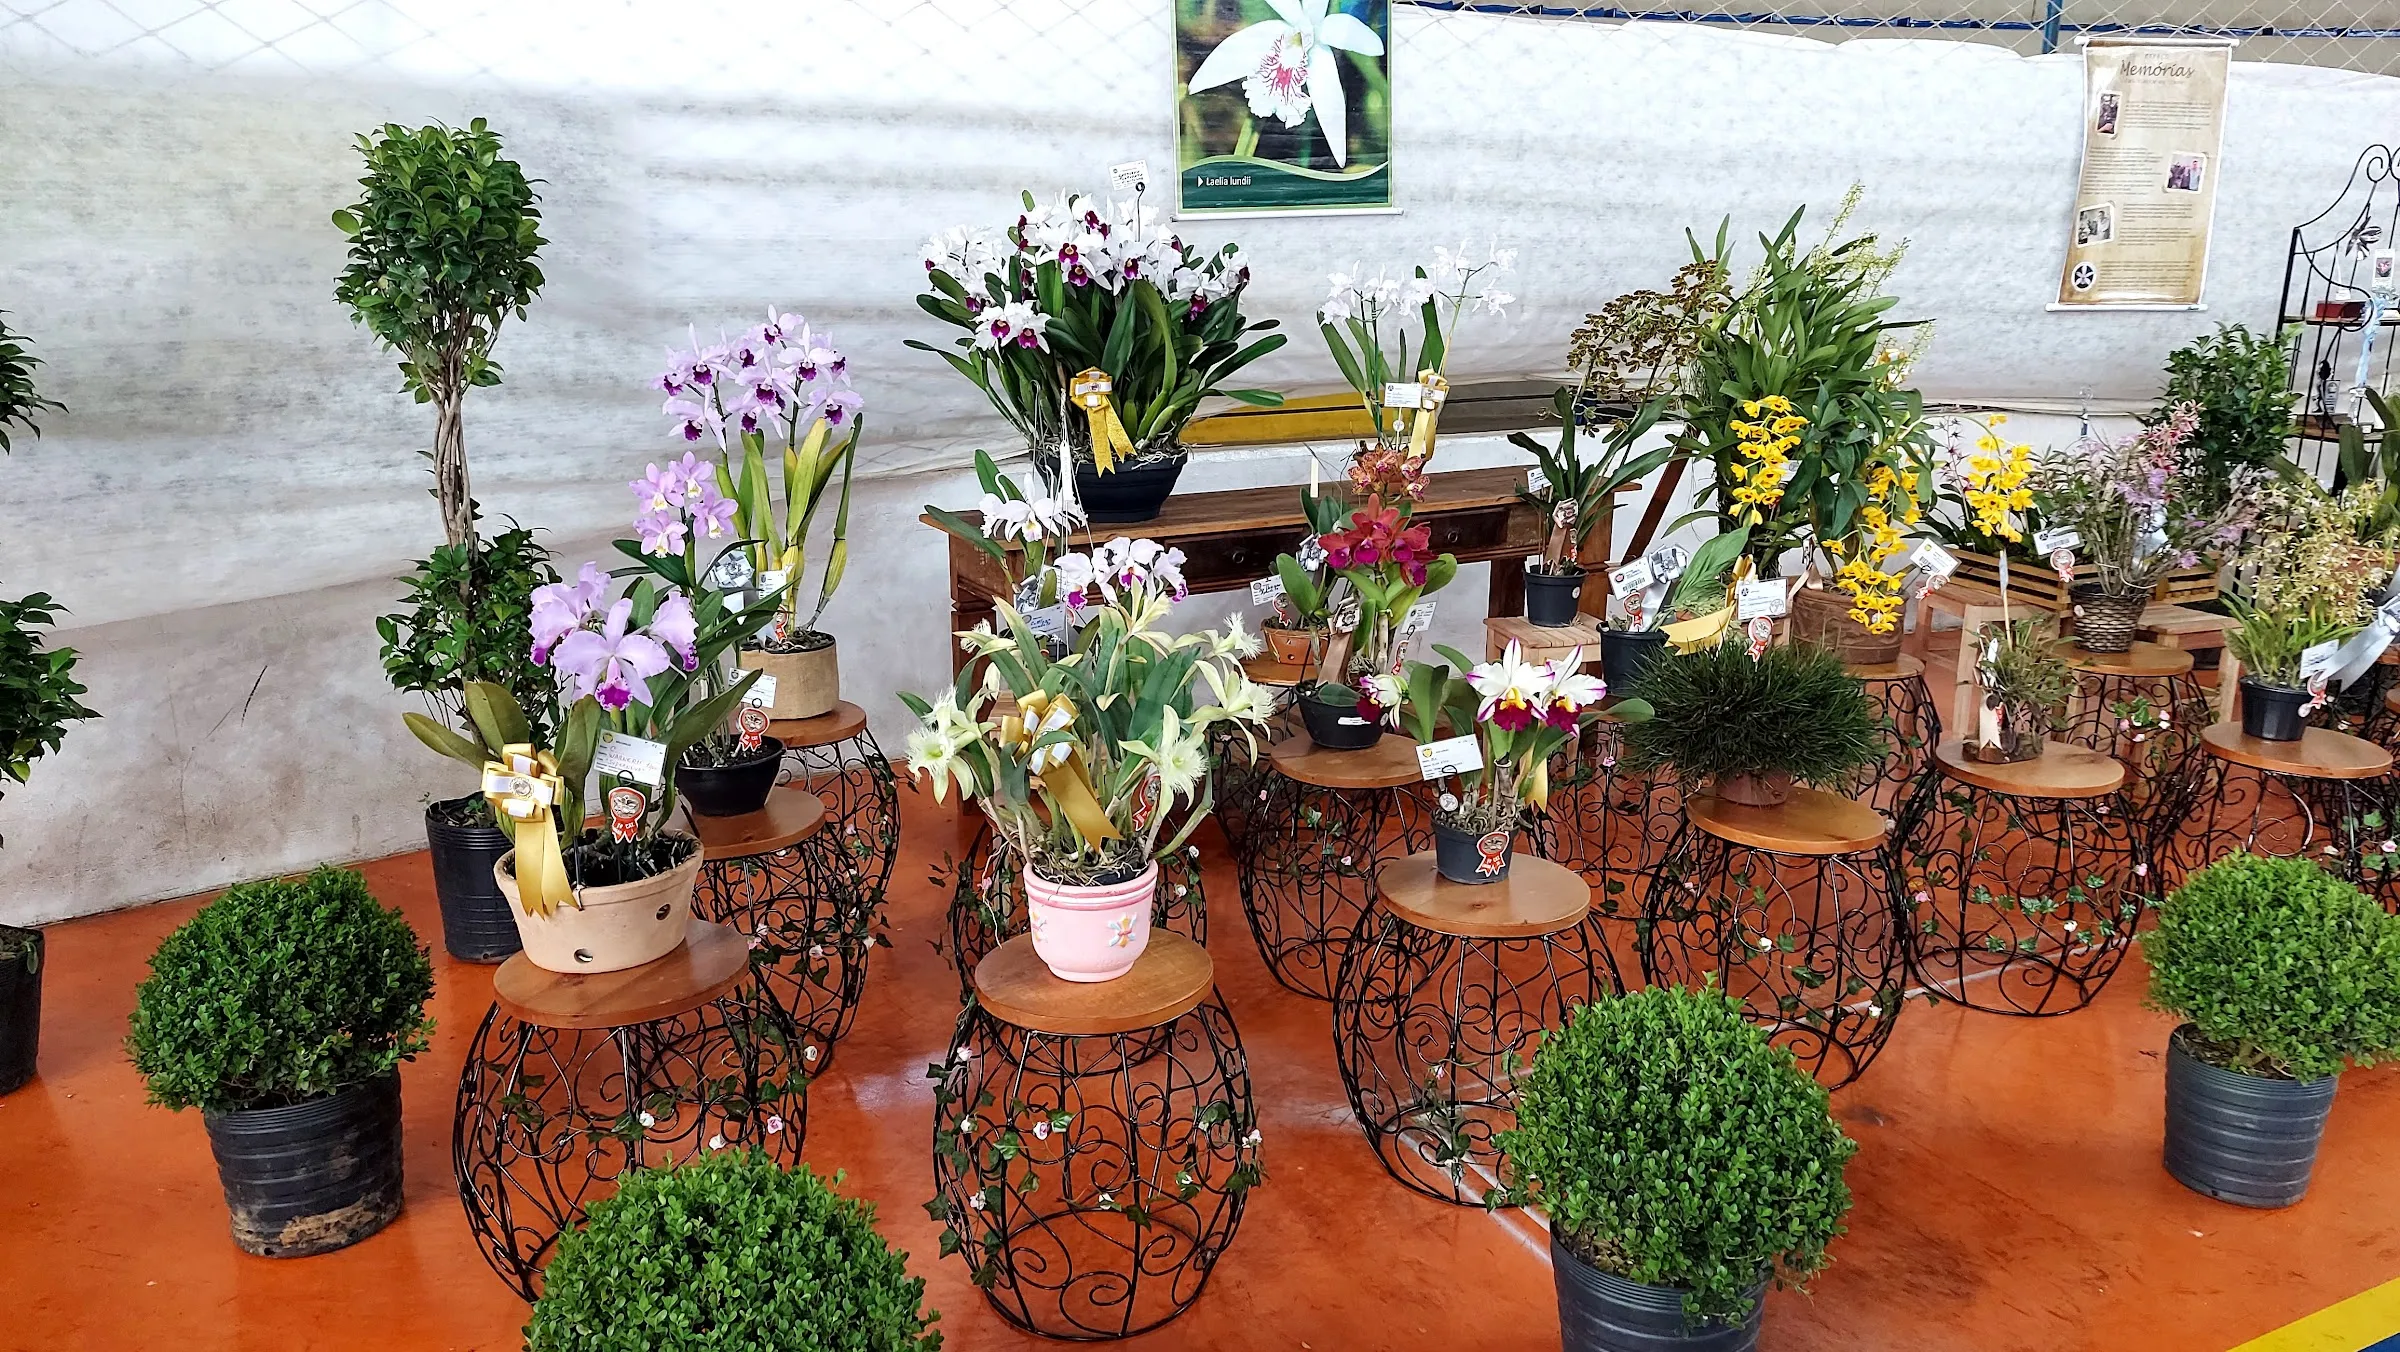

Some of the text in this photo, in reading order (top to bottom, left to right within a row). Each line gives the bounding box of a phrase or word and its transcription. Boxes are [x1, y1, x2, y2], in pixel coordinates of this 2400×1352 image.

[2120, 60, 2195, 78] Memórias
[1206, 175, 1252, 186] Laelia lundii
